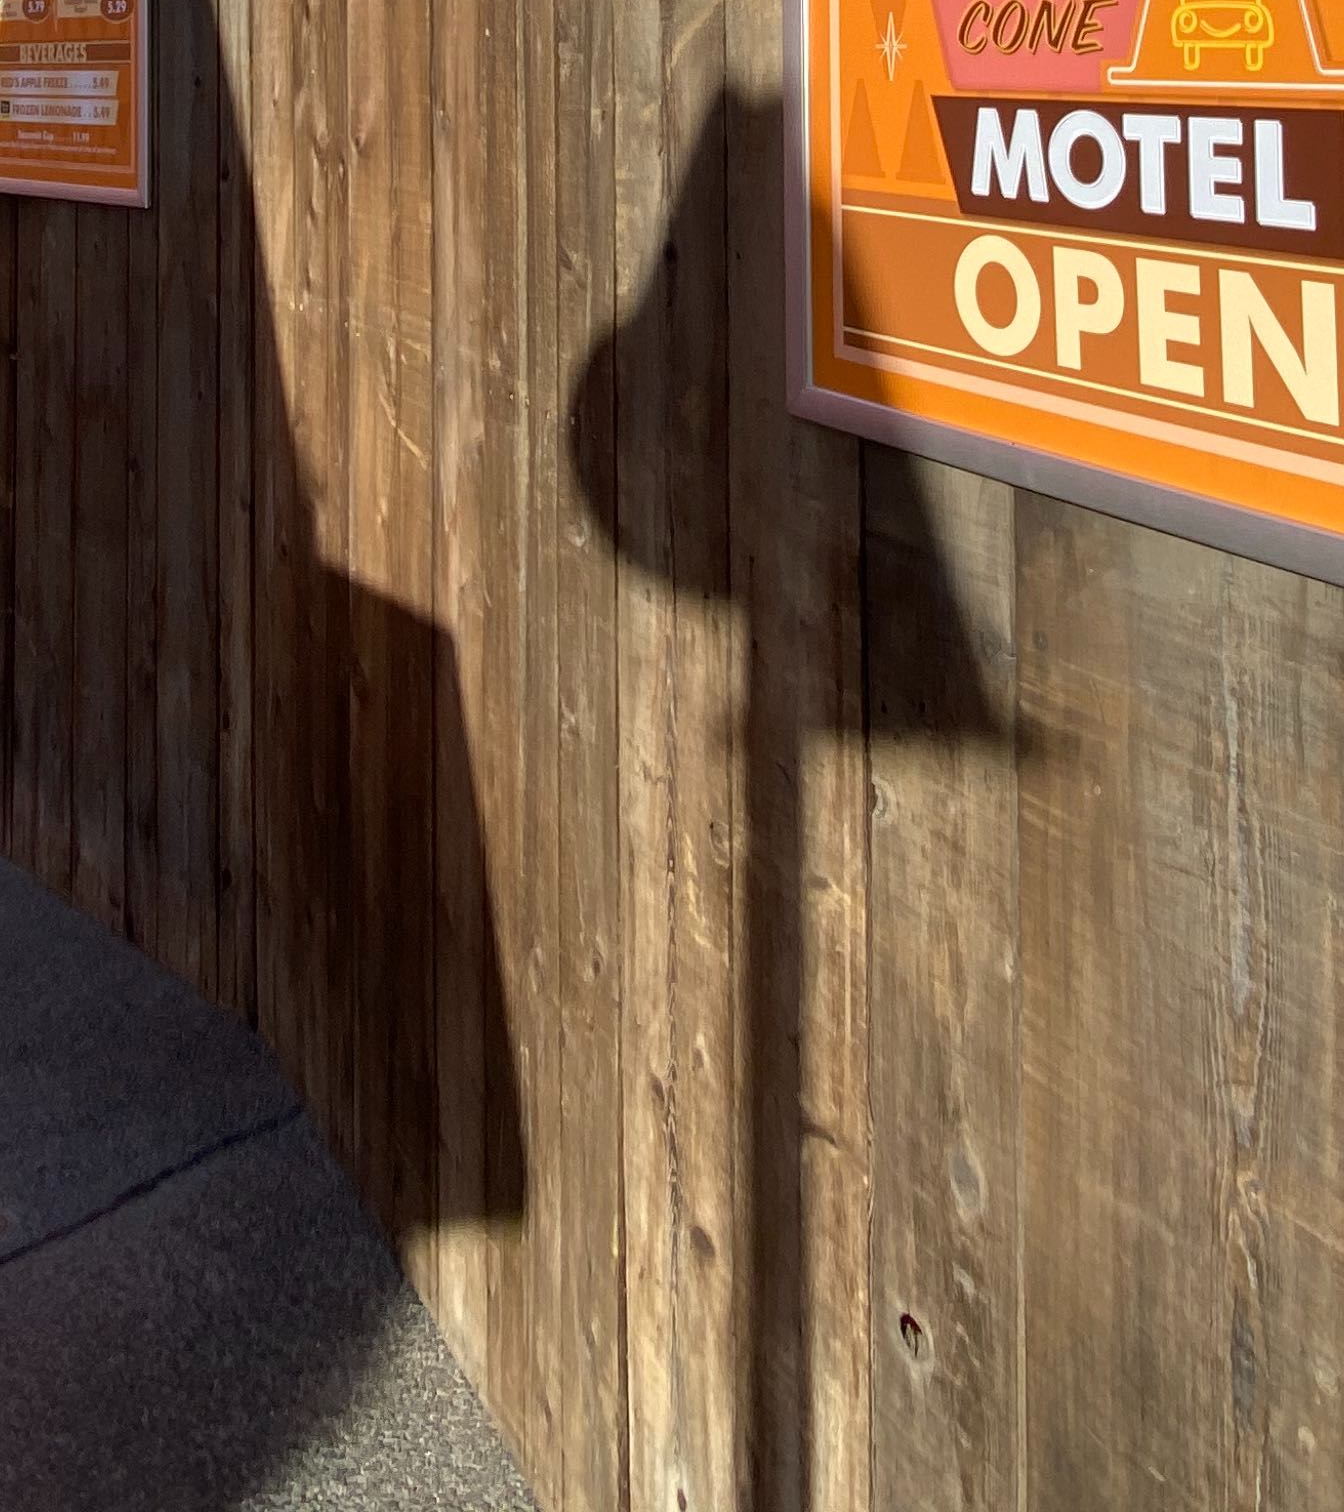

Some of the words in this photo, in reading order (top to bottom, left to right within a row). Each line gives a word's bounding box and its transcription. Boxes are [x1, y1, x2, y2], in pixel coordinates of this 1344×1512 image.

[19, 42, 88, 64] BEVERAGES
[12, 103, 40, 116] FROZEN
[41, 104, 82, 118] LEMONADE
[971, 107, 1316, 231] MOTEL
[954, 235, 1340, 427] OPEN
